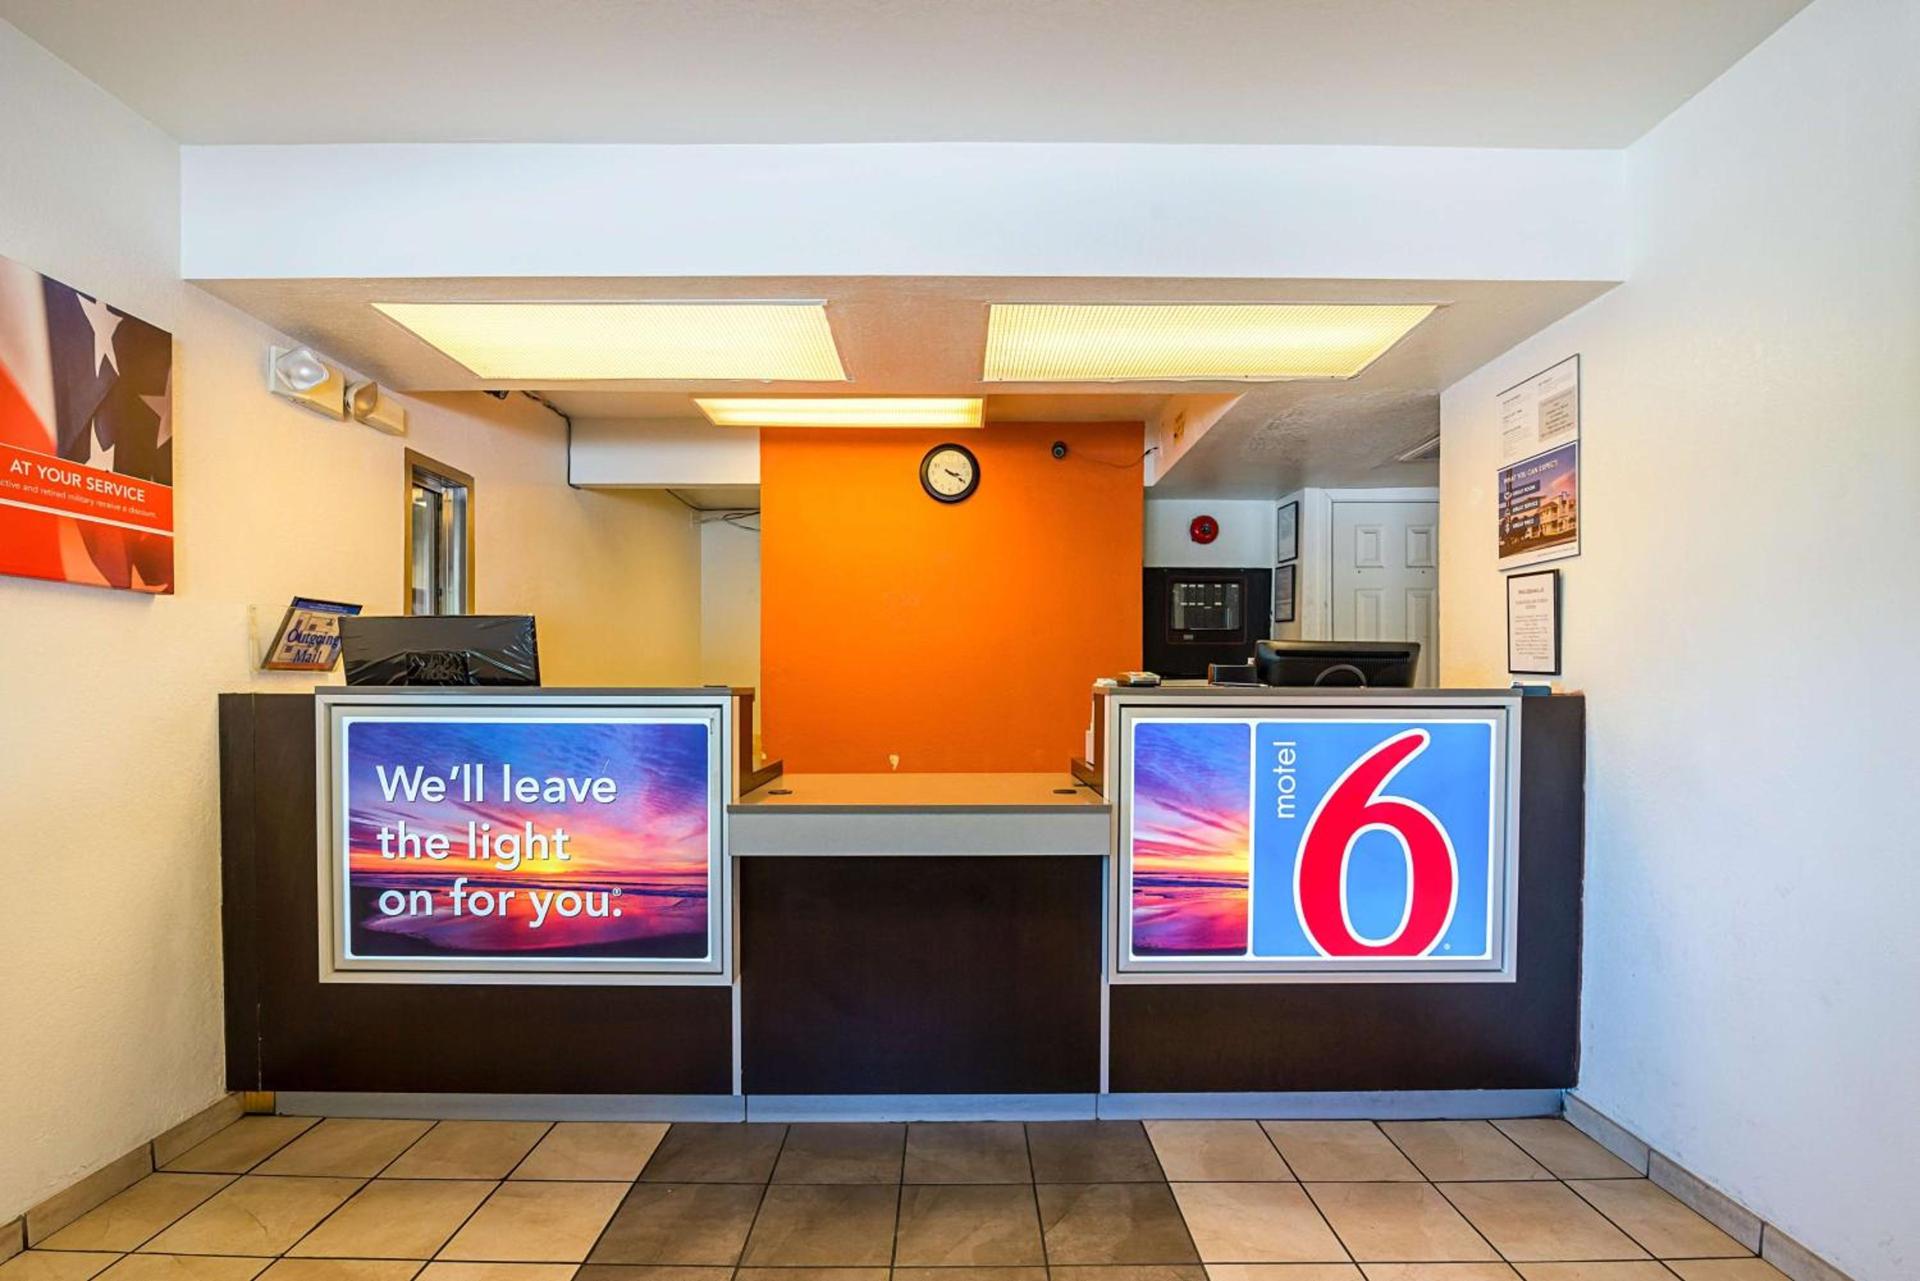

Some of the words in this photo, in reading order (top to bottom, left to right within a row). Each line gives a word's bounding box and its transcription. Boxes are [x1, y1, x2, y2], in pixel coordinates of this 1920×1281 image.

[0, 479, 20, 489] ctive
[23, 483, 39, 493] and
[40, 487, 66, 499] retired
[10, 458, 32, 476] AT
[36, 464, 82, 488] YOUR
[86, 476, 145, 502] SERVICE
[287, 628, 342, 650] Outgoing
[294, 648, 322, 664] Mail
[376, 764, 484, 803] We’ll
[503, 764, 618, 803] leave
[1273, 741, 1296, 819] motel
[376, 820, 450, 860] the
[468, 820, 571, 872] light
[1293, 728, 1459, 959] 6
[378, 888, 434, 918] on
[450, 877, 515, 918] for
